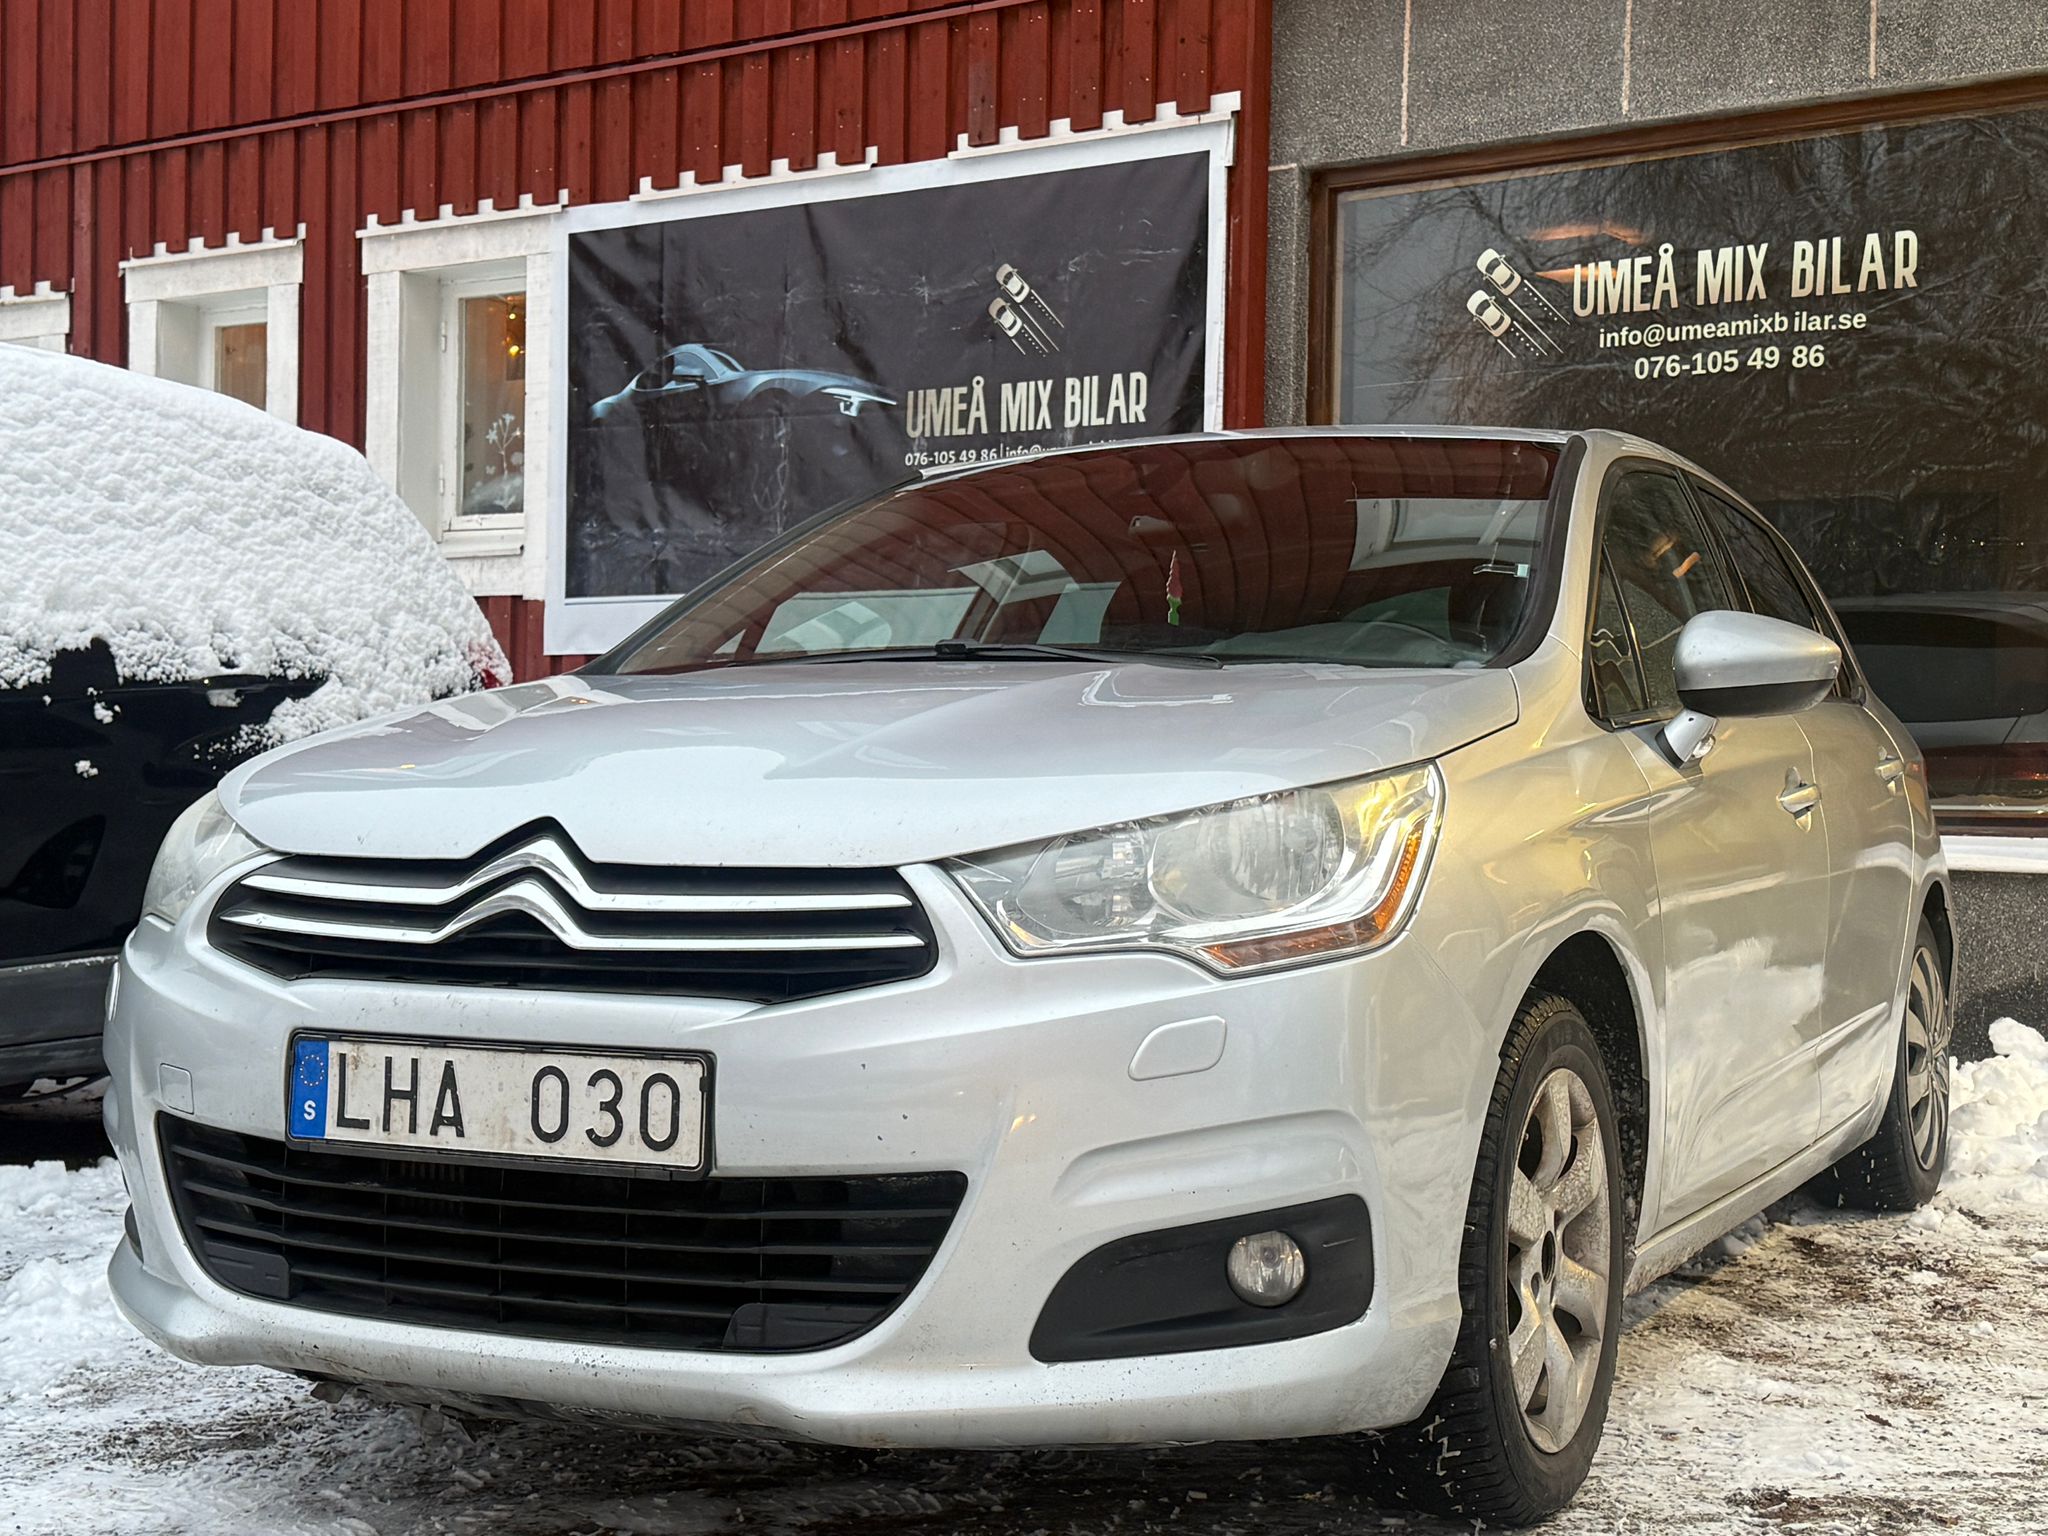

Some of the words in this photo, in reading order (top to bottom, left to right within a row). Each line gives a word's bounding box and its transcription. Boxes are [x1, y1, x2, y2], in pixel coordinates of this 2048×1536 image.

[1572, 242, 1679, 318] UMEÅ
[1696, 242, 1769, 306] MIX
[1791, 230, 1919, 298] BILAR
[1633, 350, 1740, 380] 076-105
[1747, 347, 1781, 371] 49
[1791, 344, 1826, 368] 86
[906, 375, 988, 438] UMEÅ
[1000, 379, 1053, 433] MIX
[1063, 371, 1148, 428] BILAR
[904, 450, 955, 466] 076-105
[959, 449, 977, 463] 49
[980, 448, 997, 461] 86
[303, 1100, 317, 1121] S
[336, 1052, 466, 1138] LHA
[530, 1065, 681, 1152] 030
